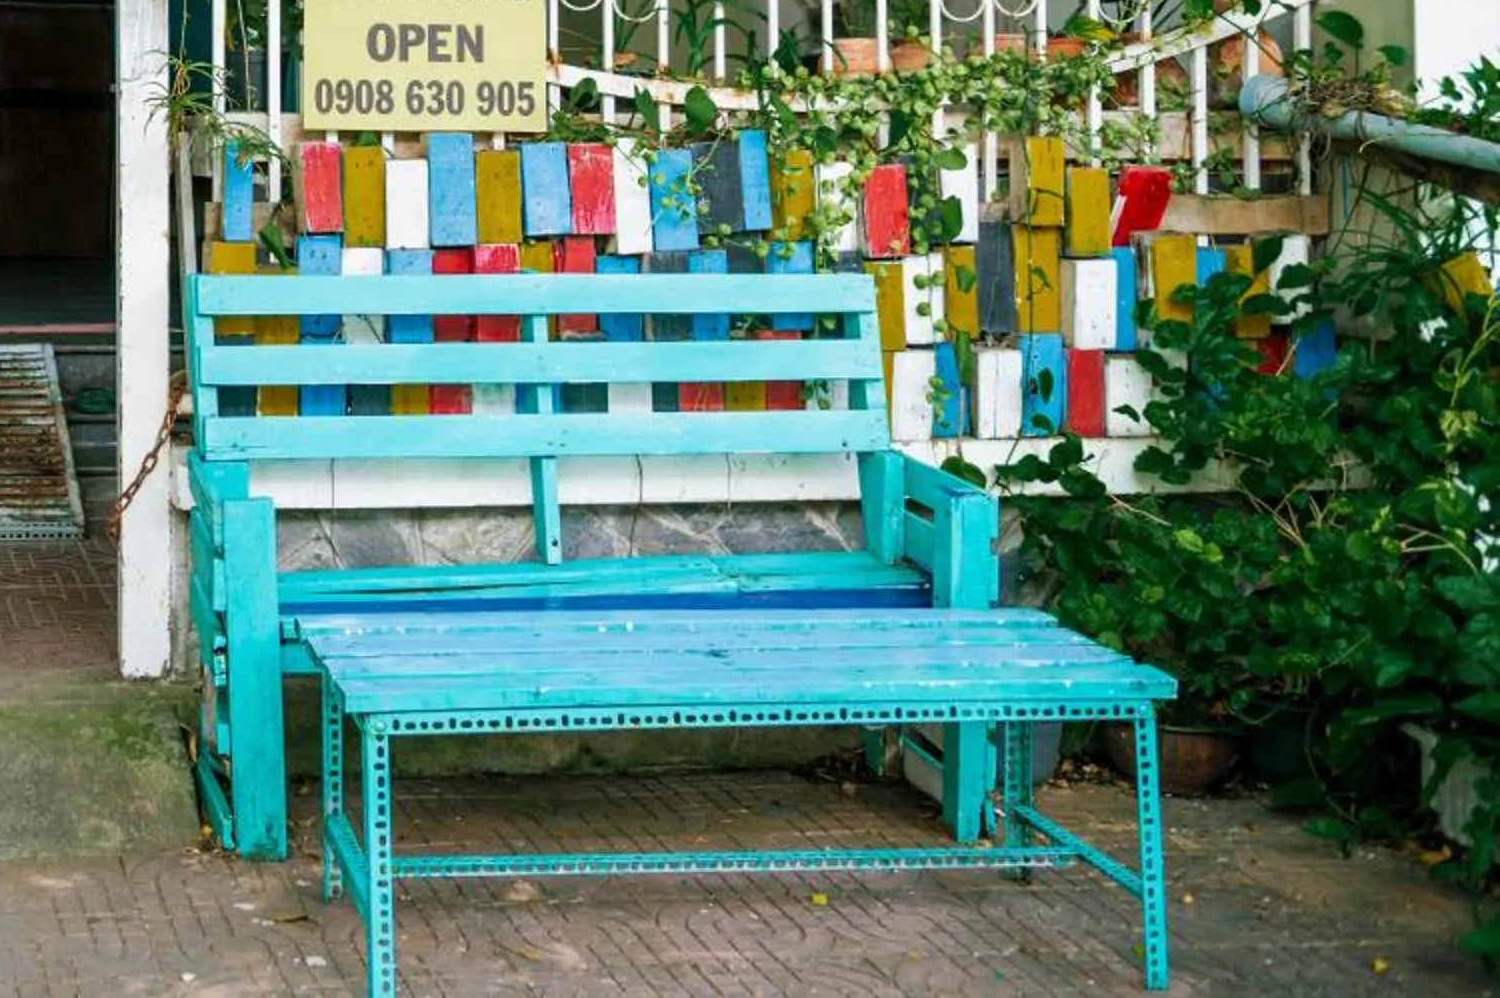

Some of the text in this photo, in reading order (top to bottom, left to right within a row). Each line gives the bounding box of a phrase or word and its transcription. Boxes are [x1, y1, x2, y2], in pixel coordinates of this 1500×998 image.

[366, 22, 484, 63] OPEN
[314, 78, 535, 116] 0908 630 905
